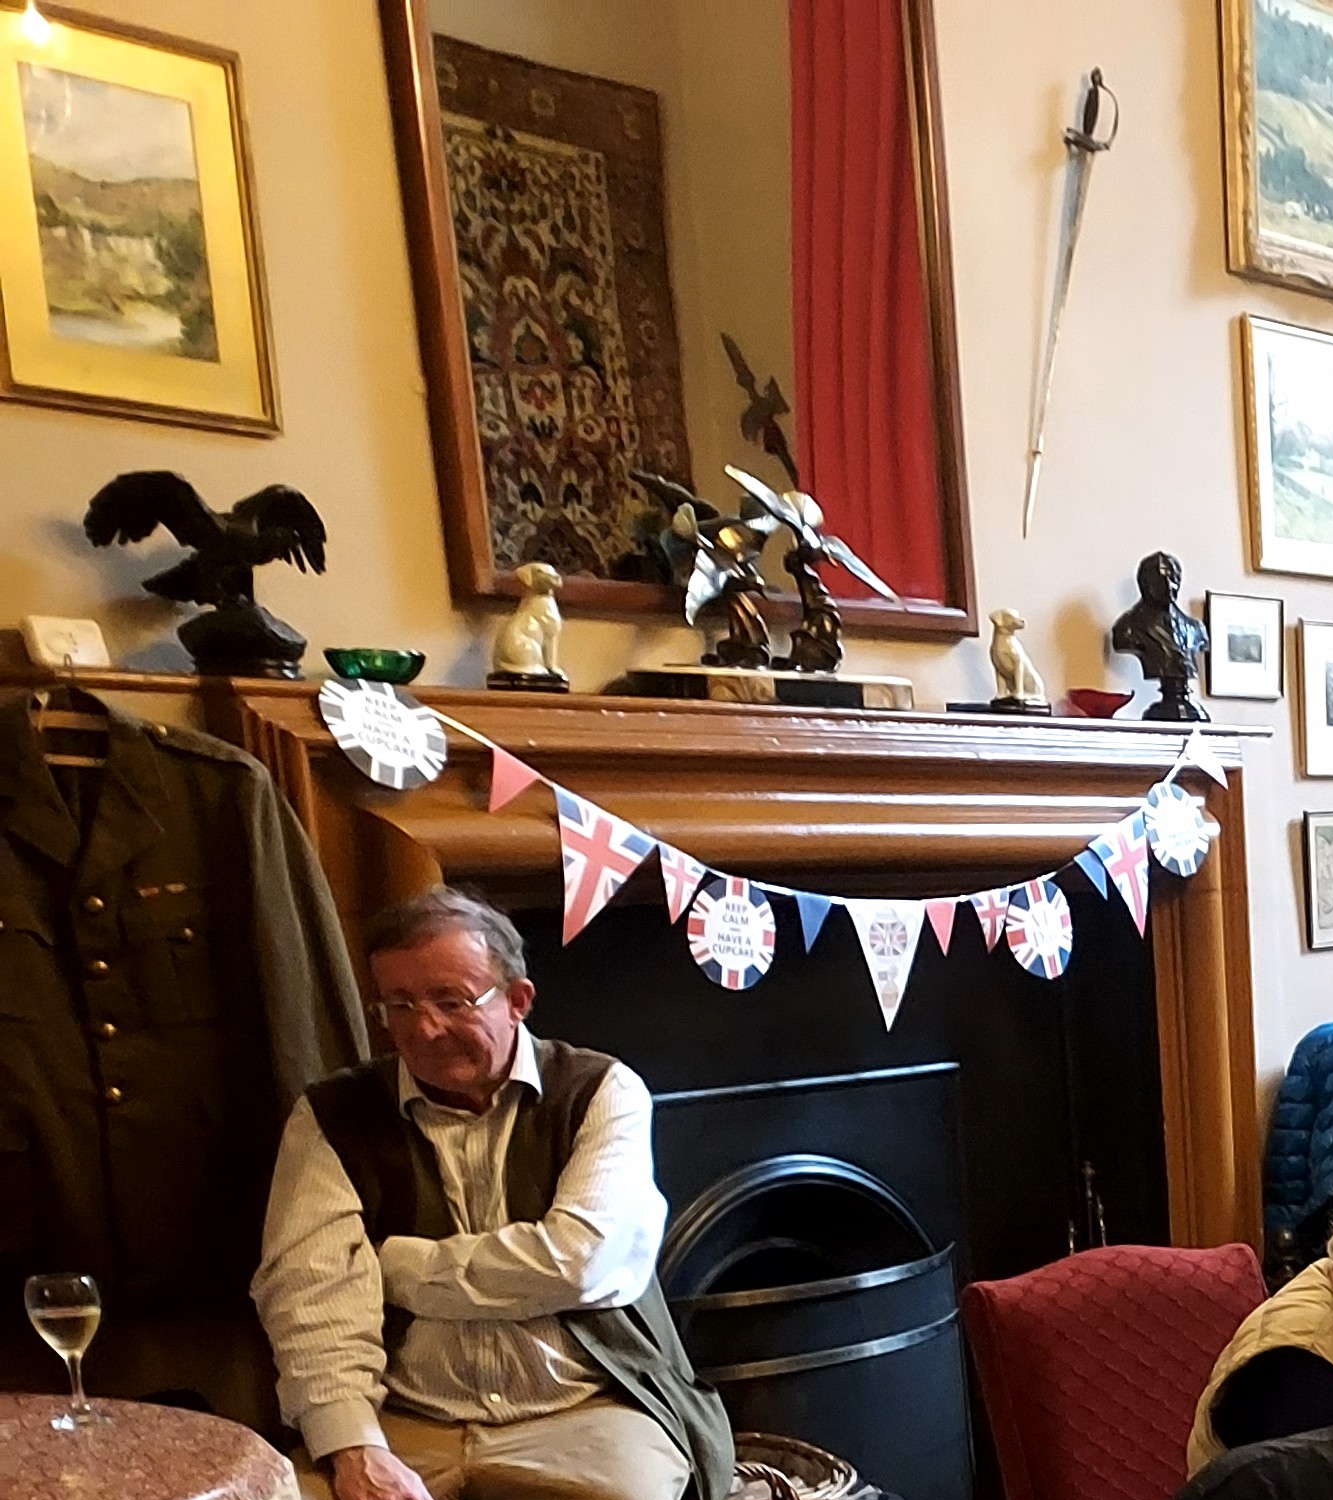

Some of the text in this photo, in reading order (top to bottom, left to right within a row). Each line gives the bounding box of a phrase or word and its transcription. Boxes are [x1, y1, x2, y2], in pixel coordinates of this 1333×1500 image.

[365, 696, 397, 711] KEEP
[364, 706, 402, 723] CALM
[363, 722, 397, 740] HAVE
[358, 731, 416, 759] CUPCAKE
[725, 902, 748, 914] KEEP
[722, 914, 749, 926] CALM
[717, 933, 751, 946] HAVE A
[712, 944, 754, 958] CUPCAKE
